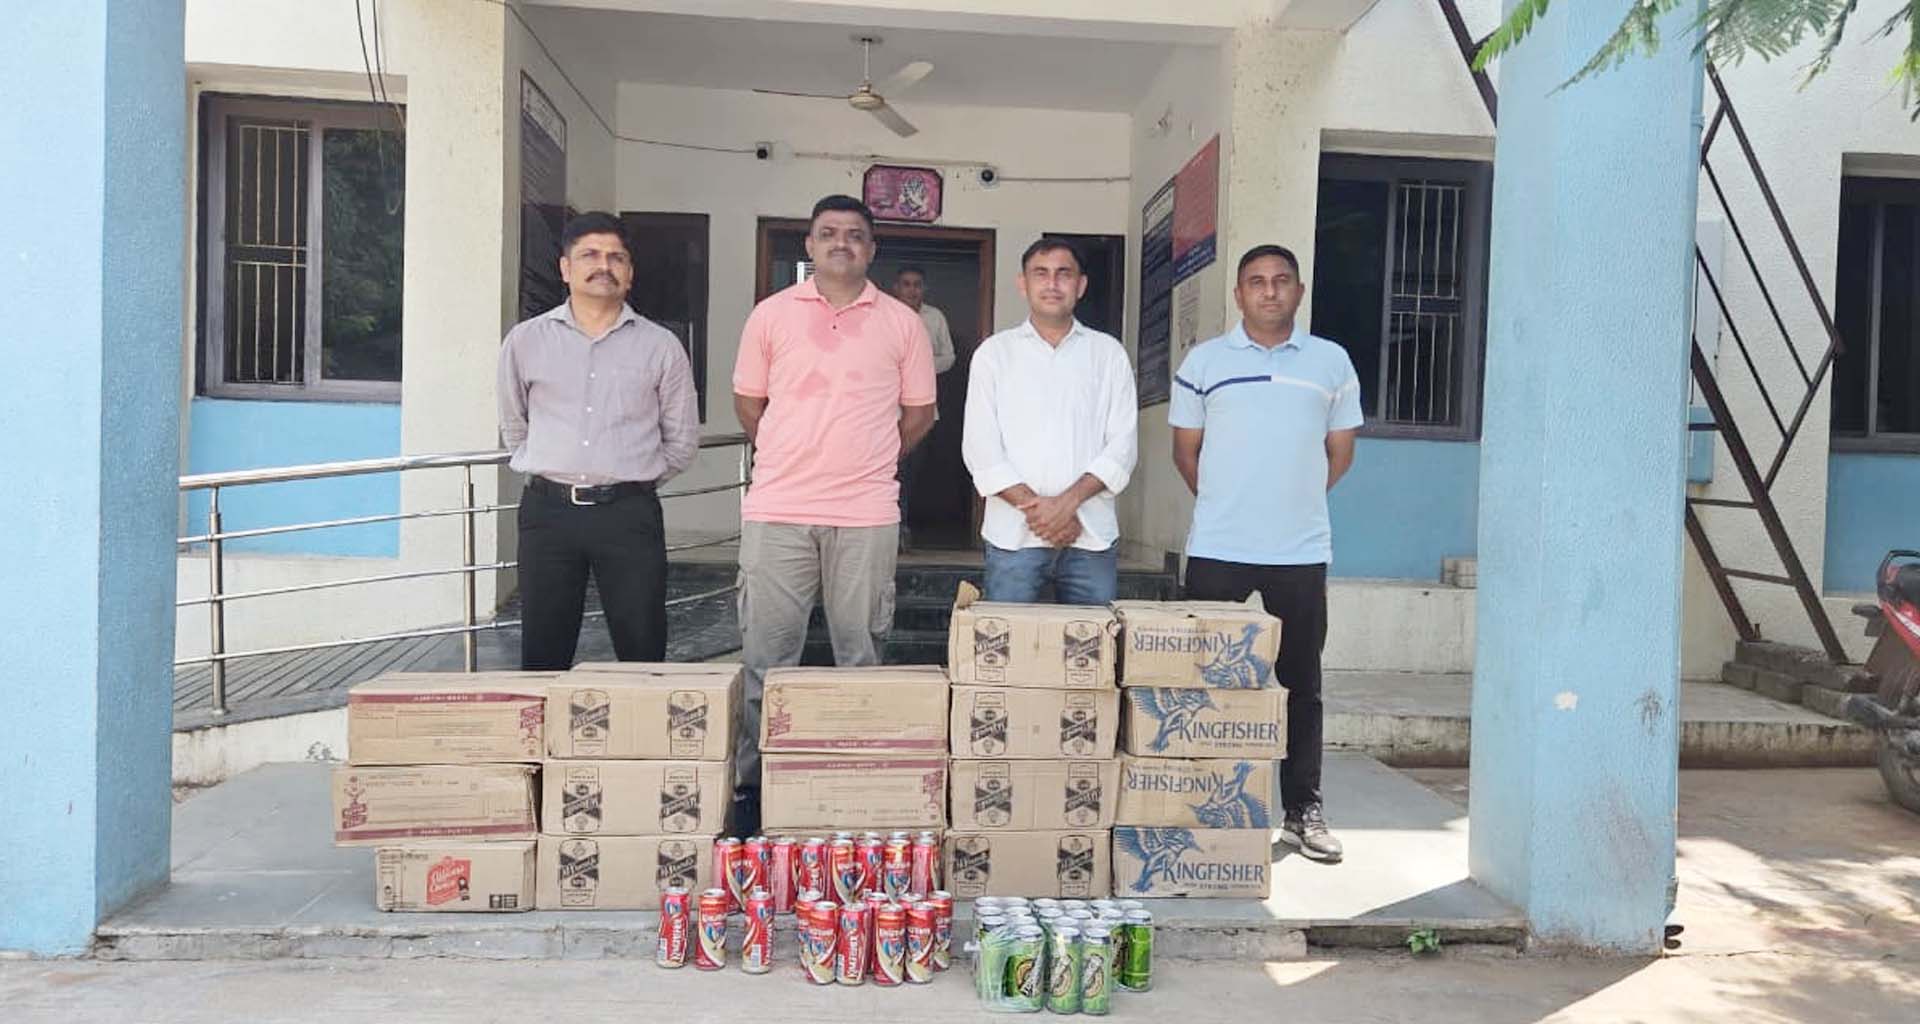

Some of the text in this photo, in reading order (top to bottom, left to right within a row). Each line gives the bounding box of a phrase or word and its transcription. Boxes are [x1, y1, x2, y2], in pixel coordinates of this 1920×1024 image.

[1134, 631, 1231, 656] KINGFISHER
[1179, 719, 1278, 742] KINGFISHER
[1128, 770, 1223, 794] KINGFISHER
[1164, 861, 1264, 884] KINGFISHER
